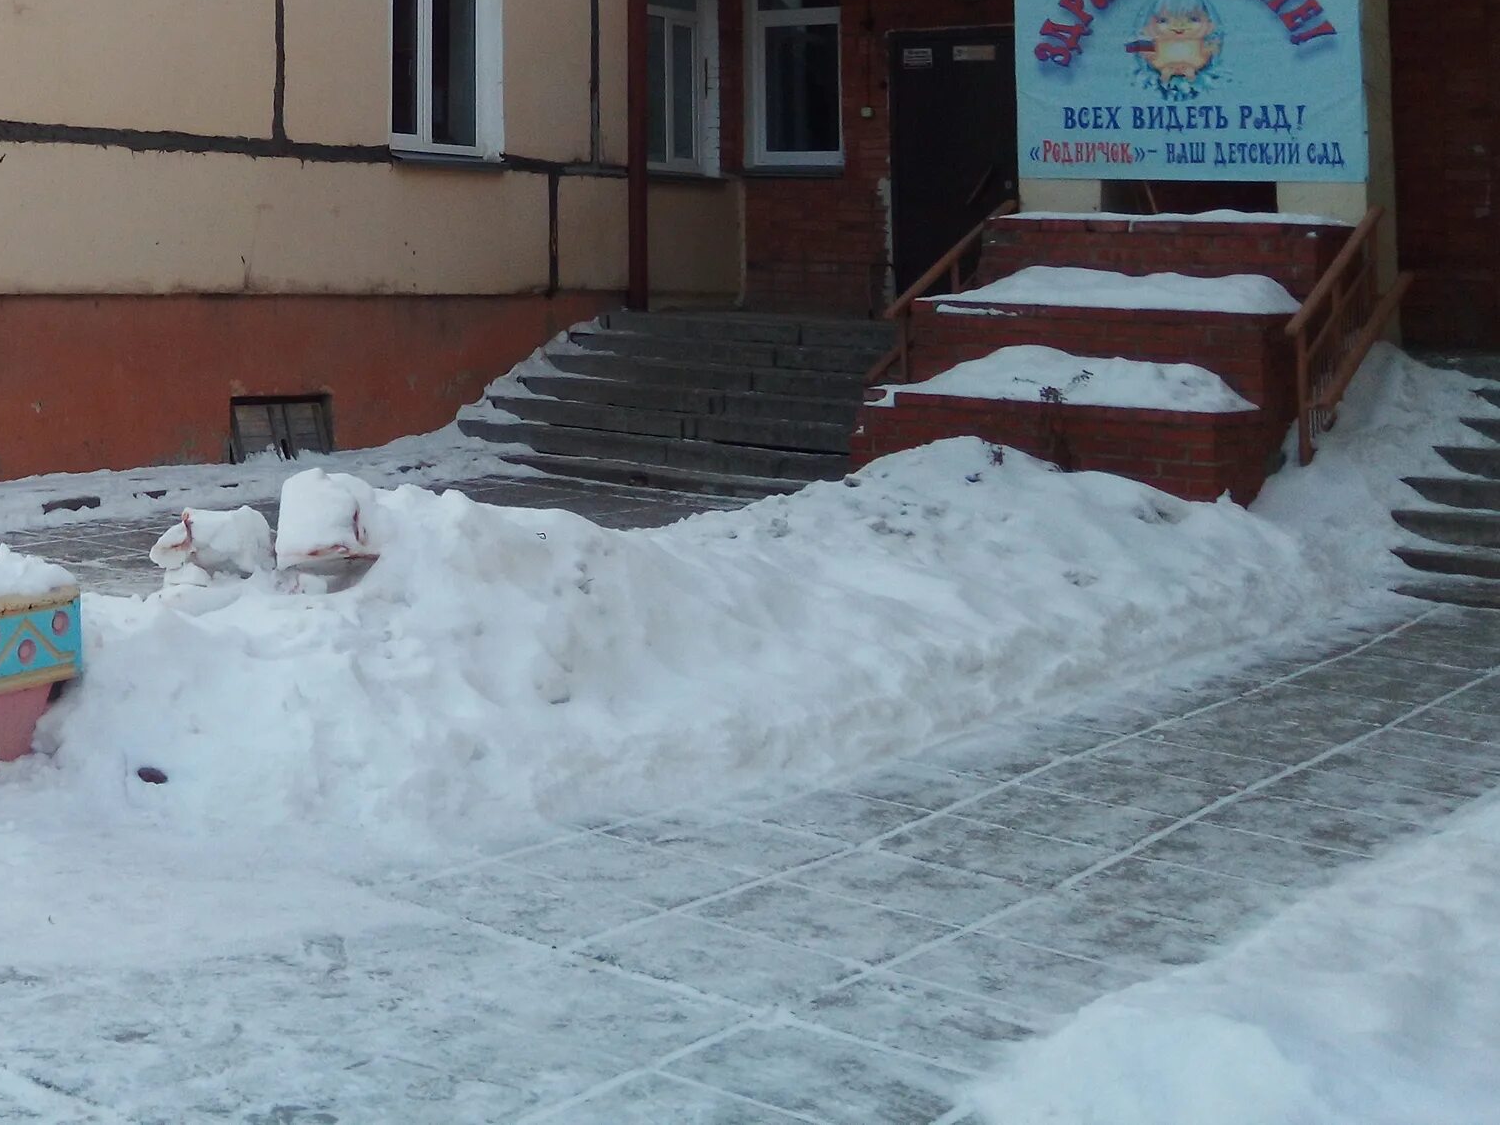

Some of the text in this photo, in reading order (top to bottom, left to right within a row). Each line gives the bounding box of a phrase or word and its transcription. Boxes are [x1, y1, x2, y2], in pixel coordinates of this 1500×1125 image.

[1062, 104, 1306, 134] ВСЕХ ВИДЕТЬ РАД!
[1165, 141, 1206, 164] НАШ
[1214, 137, 1301, 167] ДЕТСКИЙ
[1306, 141, 1347, 169] САД
